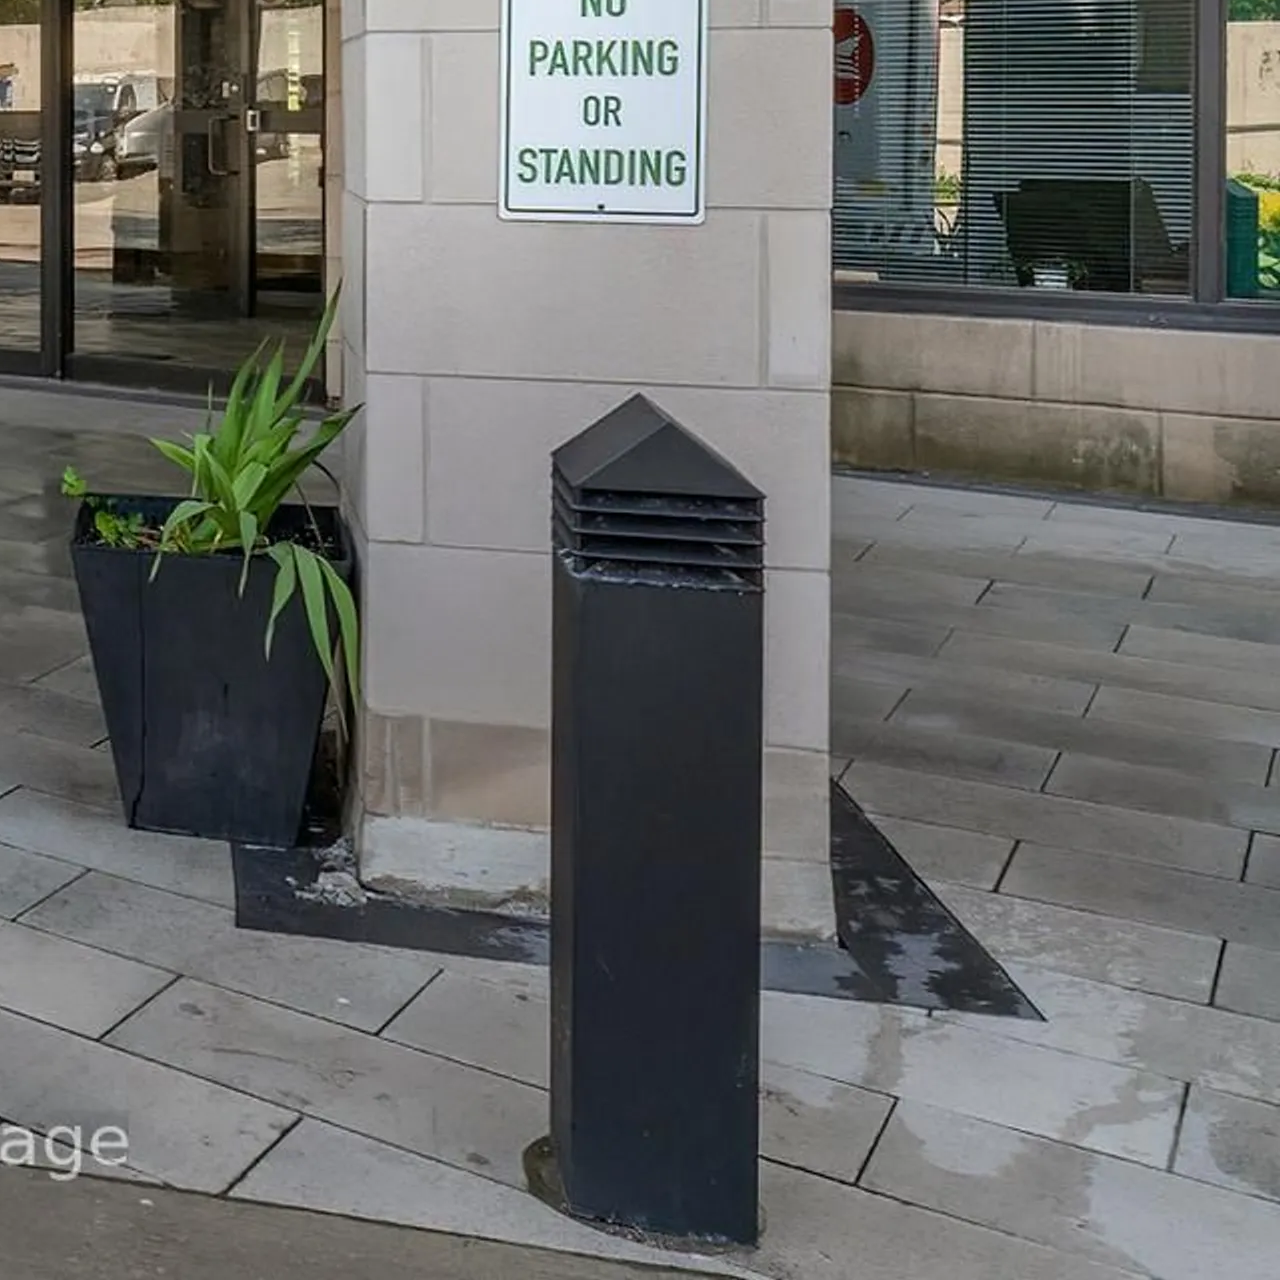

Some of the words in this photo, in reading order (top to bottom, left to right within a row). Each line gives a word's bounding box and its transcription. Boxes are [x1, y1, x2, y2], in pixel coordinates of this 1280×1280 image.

[528, 38, 680, 78] PARKING
[582, 94, 623, 128] OR
[516, 147, 688, 188] STANDING
